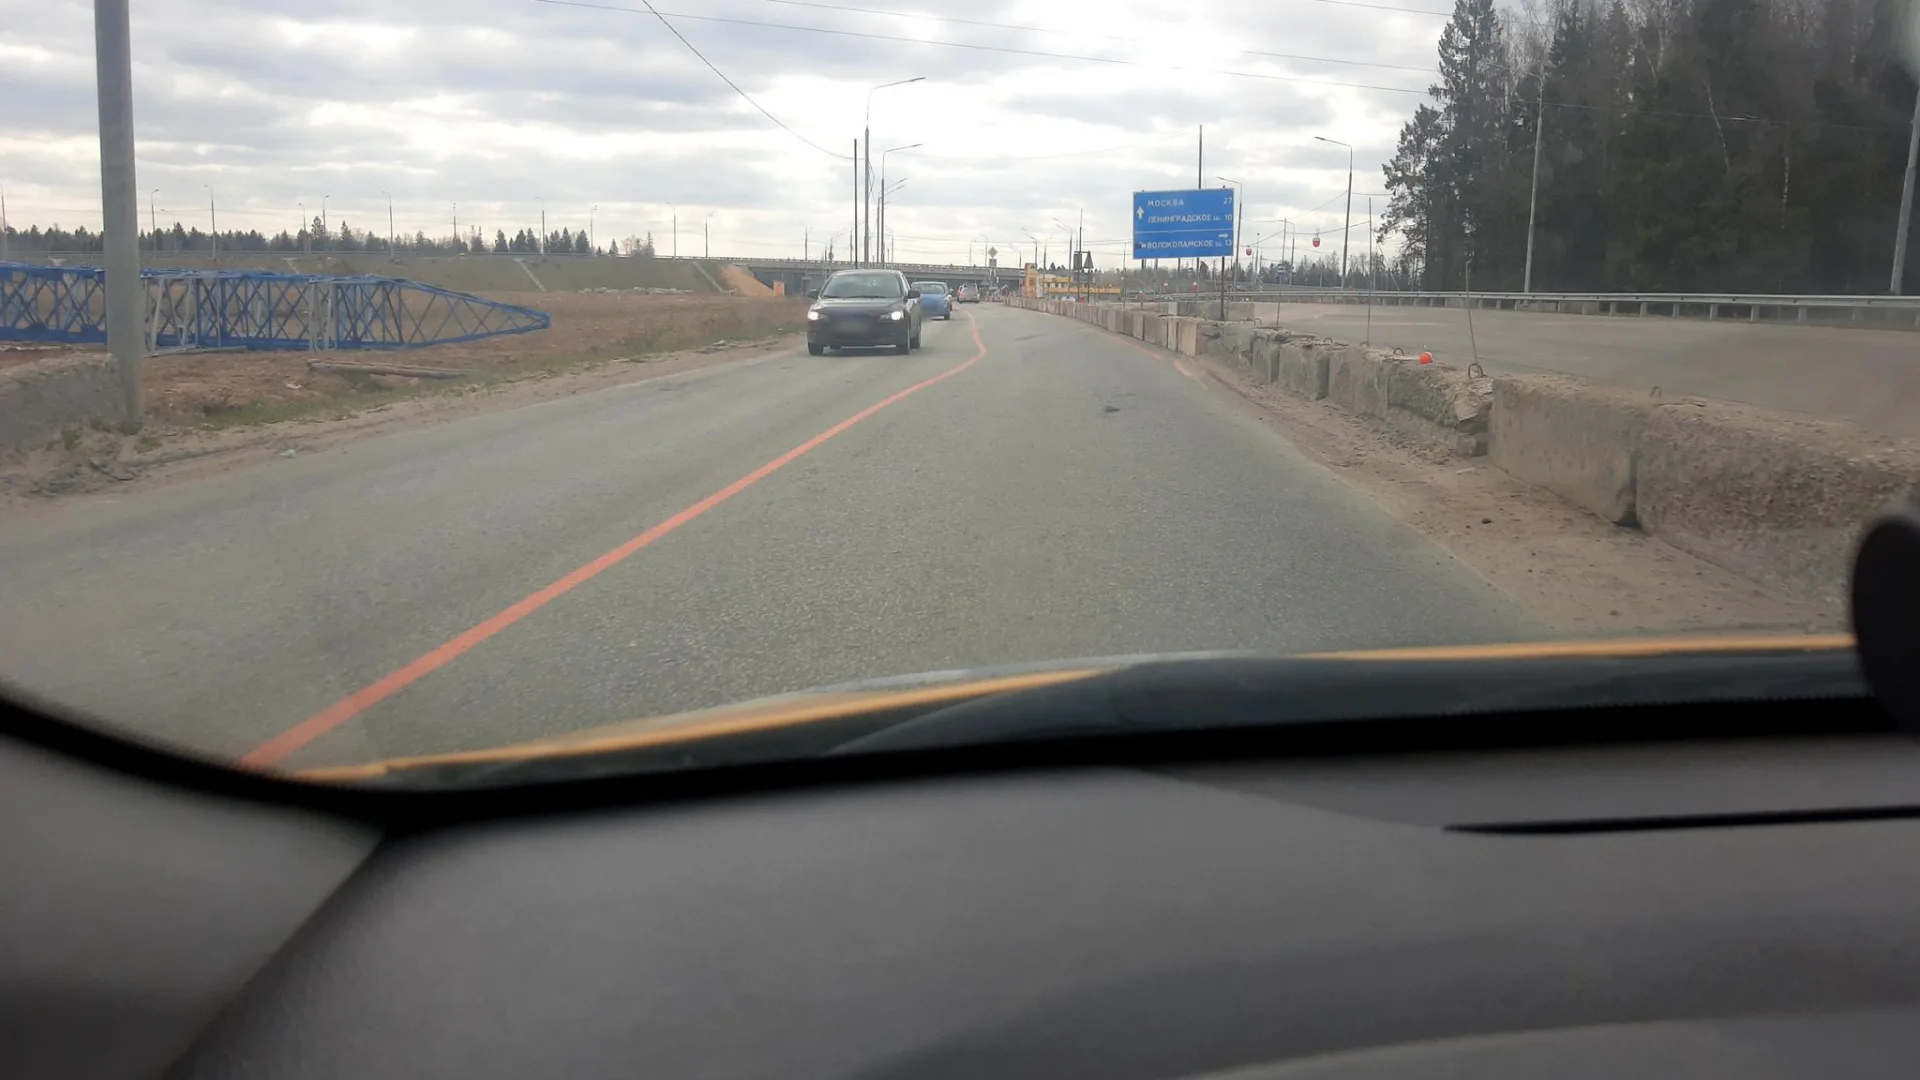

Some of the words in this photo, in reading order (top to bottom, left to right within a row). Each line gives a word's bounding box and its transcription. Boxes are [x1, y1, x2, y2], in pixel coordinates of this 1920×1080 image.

[1147, 199, 1185, 207] МОСКВА
[1223, 197, 1233, 205] 27
[1147, 214, 1211, 223] ЛЕНИНГРАДСКОЕ
[1147, 240, 1213, 249] ВОЛОКОЛАМСКОЕ
[1224, 239, 1232, 247] 13
